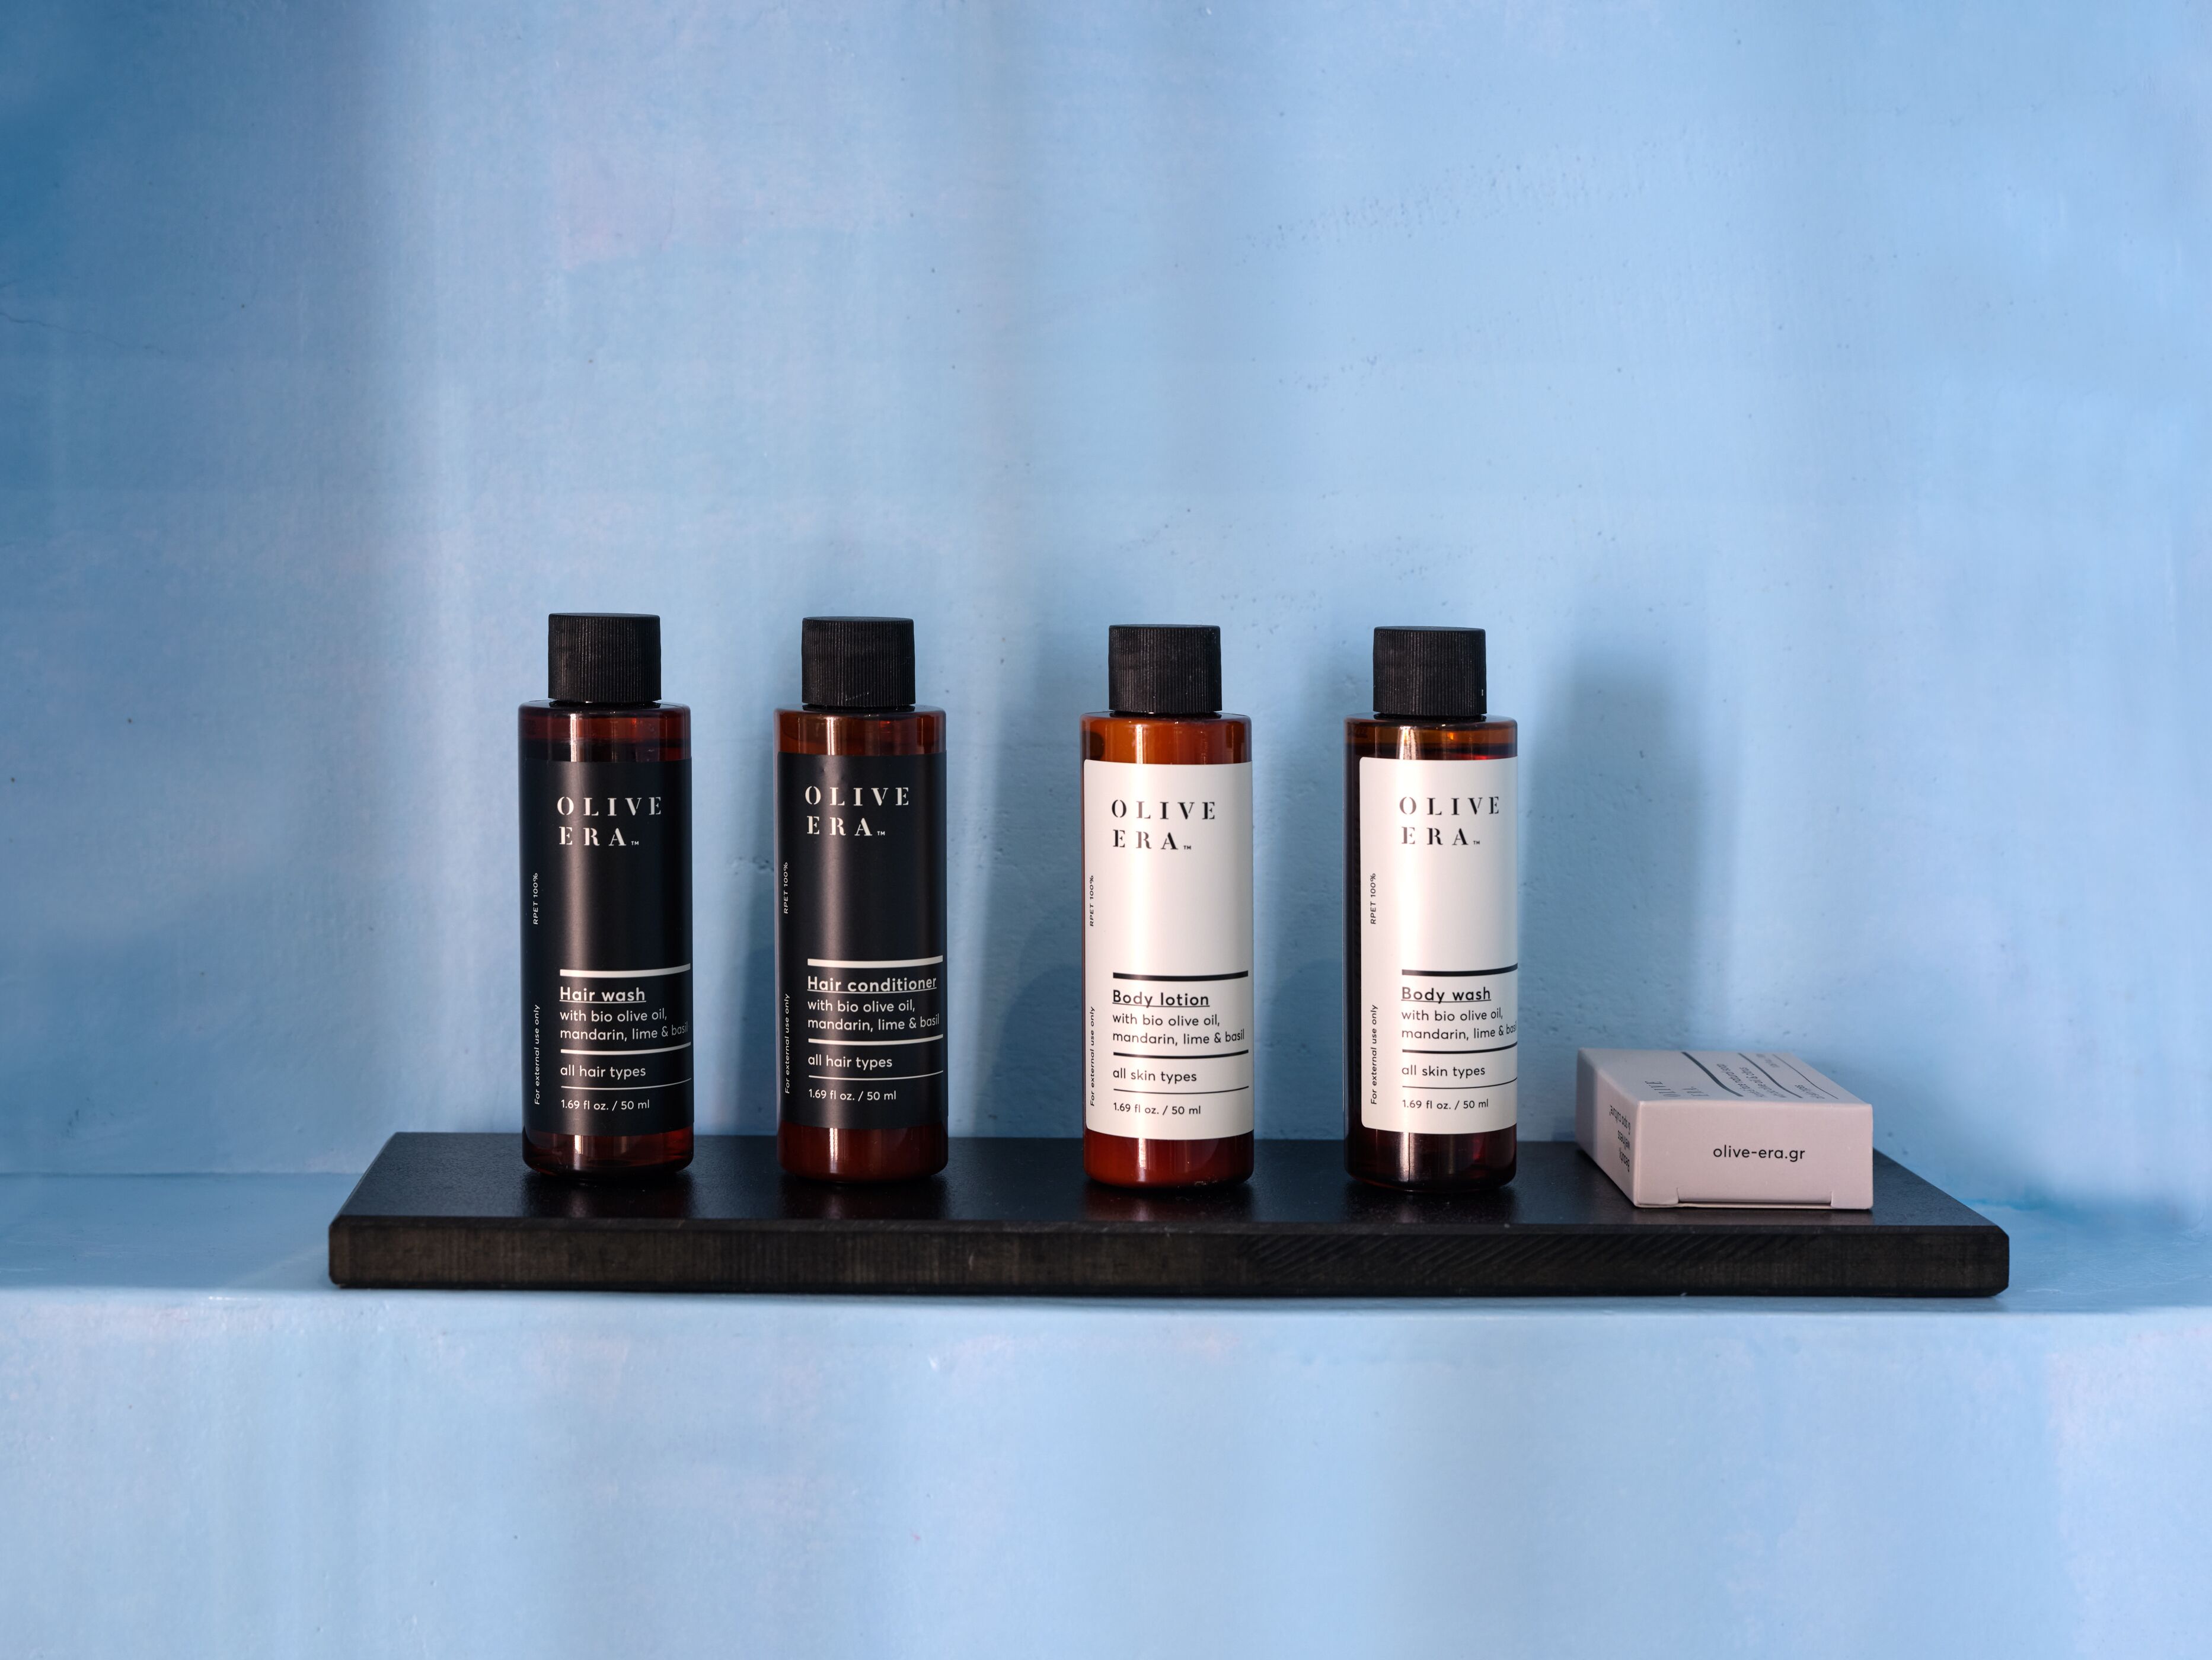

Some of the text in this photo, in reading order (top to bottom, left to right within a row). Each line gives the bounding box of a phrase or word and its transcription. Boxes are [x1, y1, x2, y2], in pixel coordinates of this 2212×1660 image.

[805, 786, 909, 806] OLIVE
[557, 797, 662, 816] OLIVE
[1112, 799, 1215, 819] OLIVE
[1399, 796, 1499, 815] OLIVE
[807, 976, 937, 992] Hair conditioner
[560, 987, 645, 1001] Hair wash
[1113, 989, 1209, 1008] Body lotion
[1402, 986, 1490, 1004] Body wash
[807, 999, 915, 1013] with bio olive oil,
[1402, 1007, 1503, 1021] with bio olive oil,
[560, 1008, 668, 1022] with bio olive oil,
[807, 1013, 939, 1032] mandarin, lime & basil
[1113, 1013, 1220, 1026] with bio olive oil,
[560, 1021, 688, 1042] mandarin, lime & basil
[1113, 1029, 1244, 1046] mandarin, lime & basil
[1402, 1029, 1469, 1040] mandarin,
[1473, 1027, 1495, 1039] lime
[1499, 1025, 1504, 1036] &
[807, 1054, 893, 1071] all hair types
[560, 1065, 646, 1080] all hair types
[1113, 1068, 1197, 1084] all skin types
[1402, 1064, 1486, 1078] all skin types
[809, 1088, 826, 1098] 1.69
[830, 1090, 836, 1100] fl
[858, 1091, 863, 1102] /
[867, 1091, 880, 1100] 50
[884, 1091, 896, 1100] ml
[561, 1100, 580, 1109] 1.69
[583, 1100, 589, 1110] fl
[612, 1100, 617, 1111] /
[621, 1101, 634, 1110] 50
[638, 1100, 650, 1109] ml
[1113, 1102, 1201, 1115] 1.69 fl oz. / 50 ml
[1402, 1100, 1422, 1109] 1.69
[1426, 1100, 1432, 1109] fl
[1454, 1100, 1460, 1110] /
[1463, 1100, 1475, 1109] 50
[1479, 1099, 1489, 1108] ml
[1713, 1145, 1806, 1163] olive-era.gr
